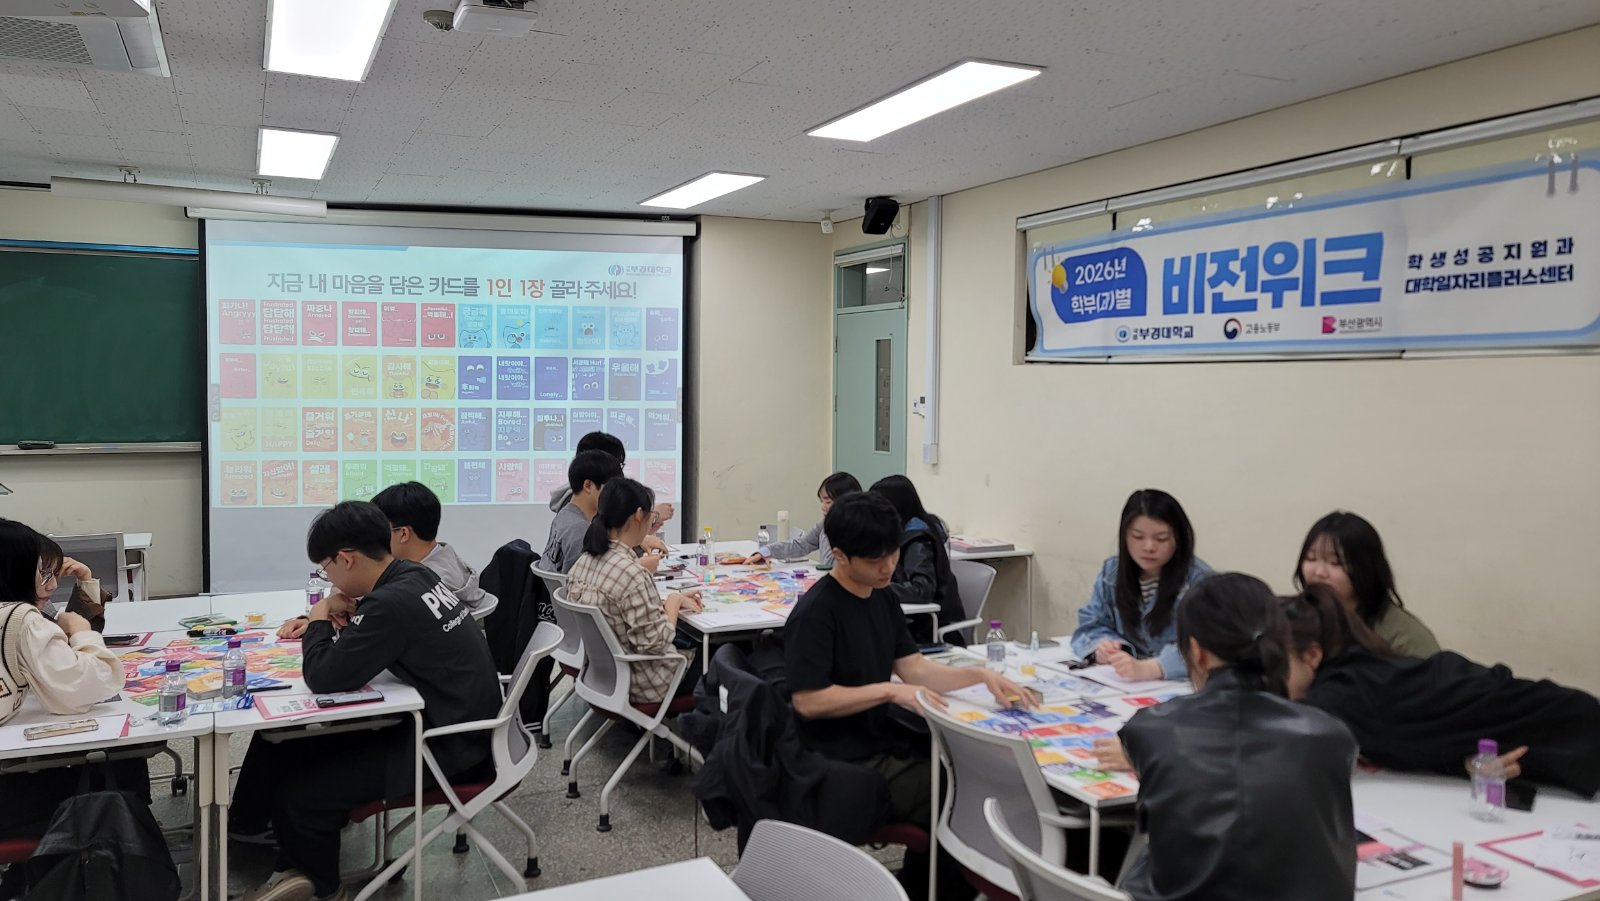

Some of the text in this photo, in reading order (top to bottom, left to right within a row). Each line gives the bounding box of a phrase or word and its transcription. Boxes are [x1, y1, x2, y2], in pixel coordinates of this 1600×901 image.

[1408, 237, 1573, 270] 학생성공지원과
[1075, 257, 1127, 285] 2026년
[1163, 232, 1383, 315] 비전위크
[1405, 265, 1573, 294] 대학일자리플러스센터
[267, 273, 304, 293] 지금
[309, 273, 327, 294] 내
[332, 274, 385, 295] 마음을
[390, 276, 425, 296] 담은
[429, 277, 480, 297] 카드를
[487, 278, 512, 298] 1인
[520, 279, 545, 299] 1장
[263, 308, 295, 318] 답답해
[307, 304, 333, 313] 짜증나
[1339, 317, 1382, 329] 부산광역시
[612, 363, 639, 373] 우울해
